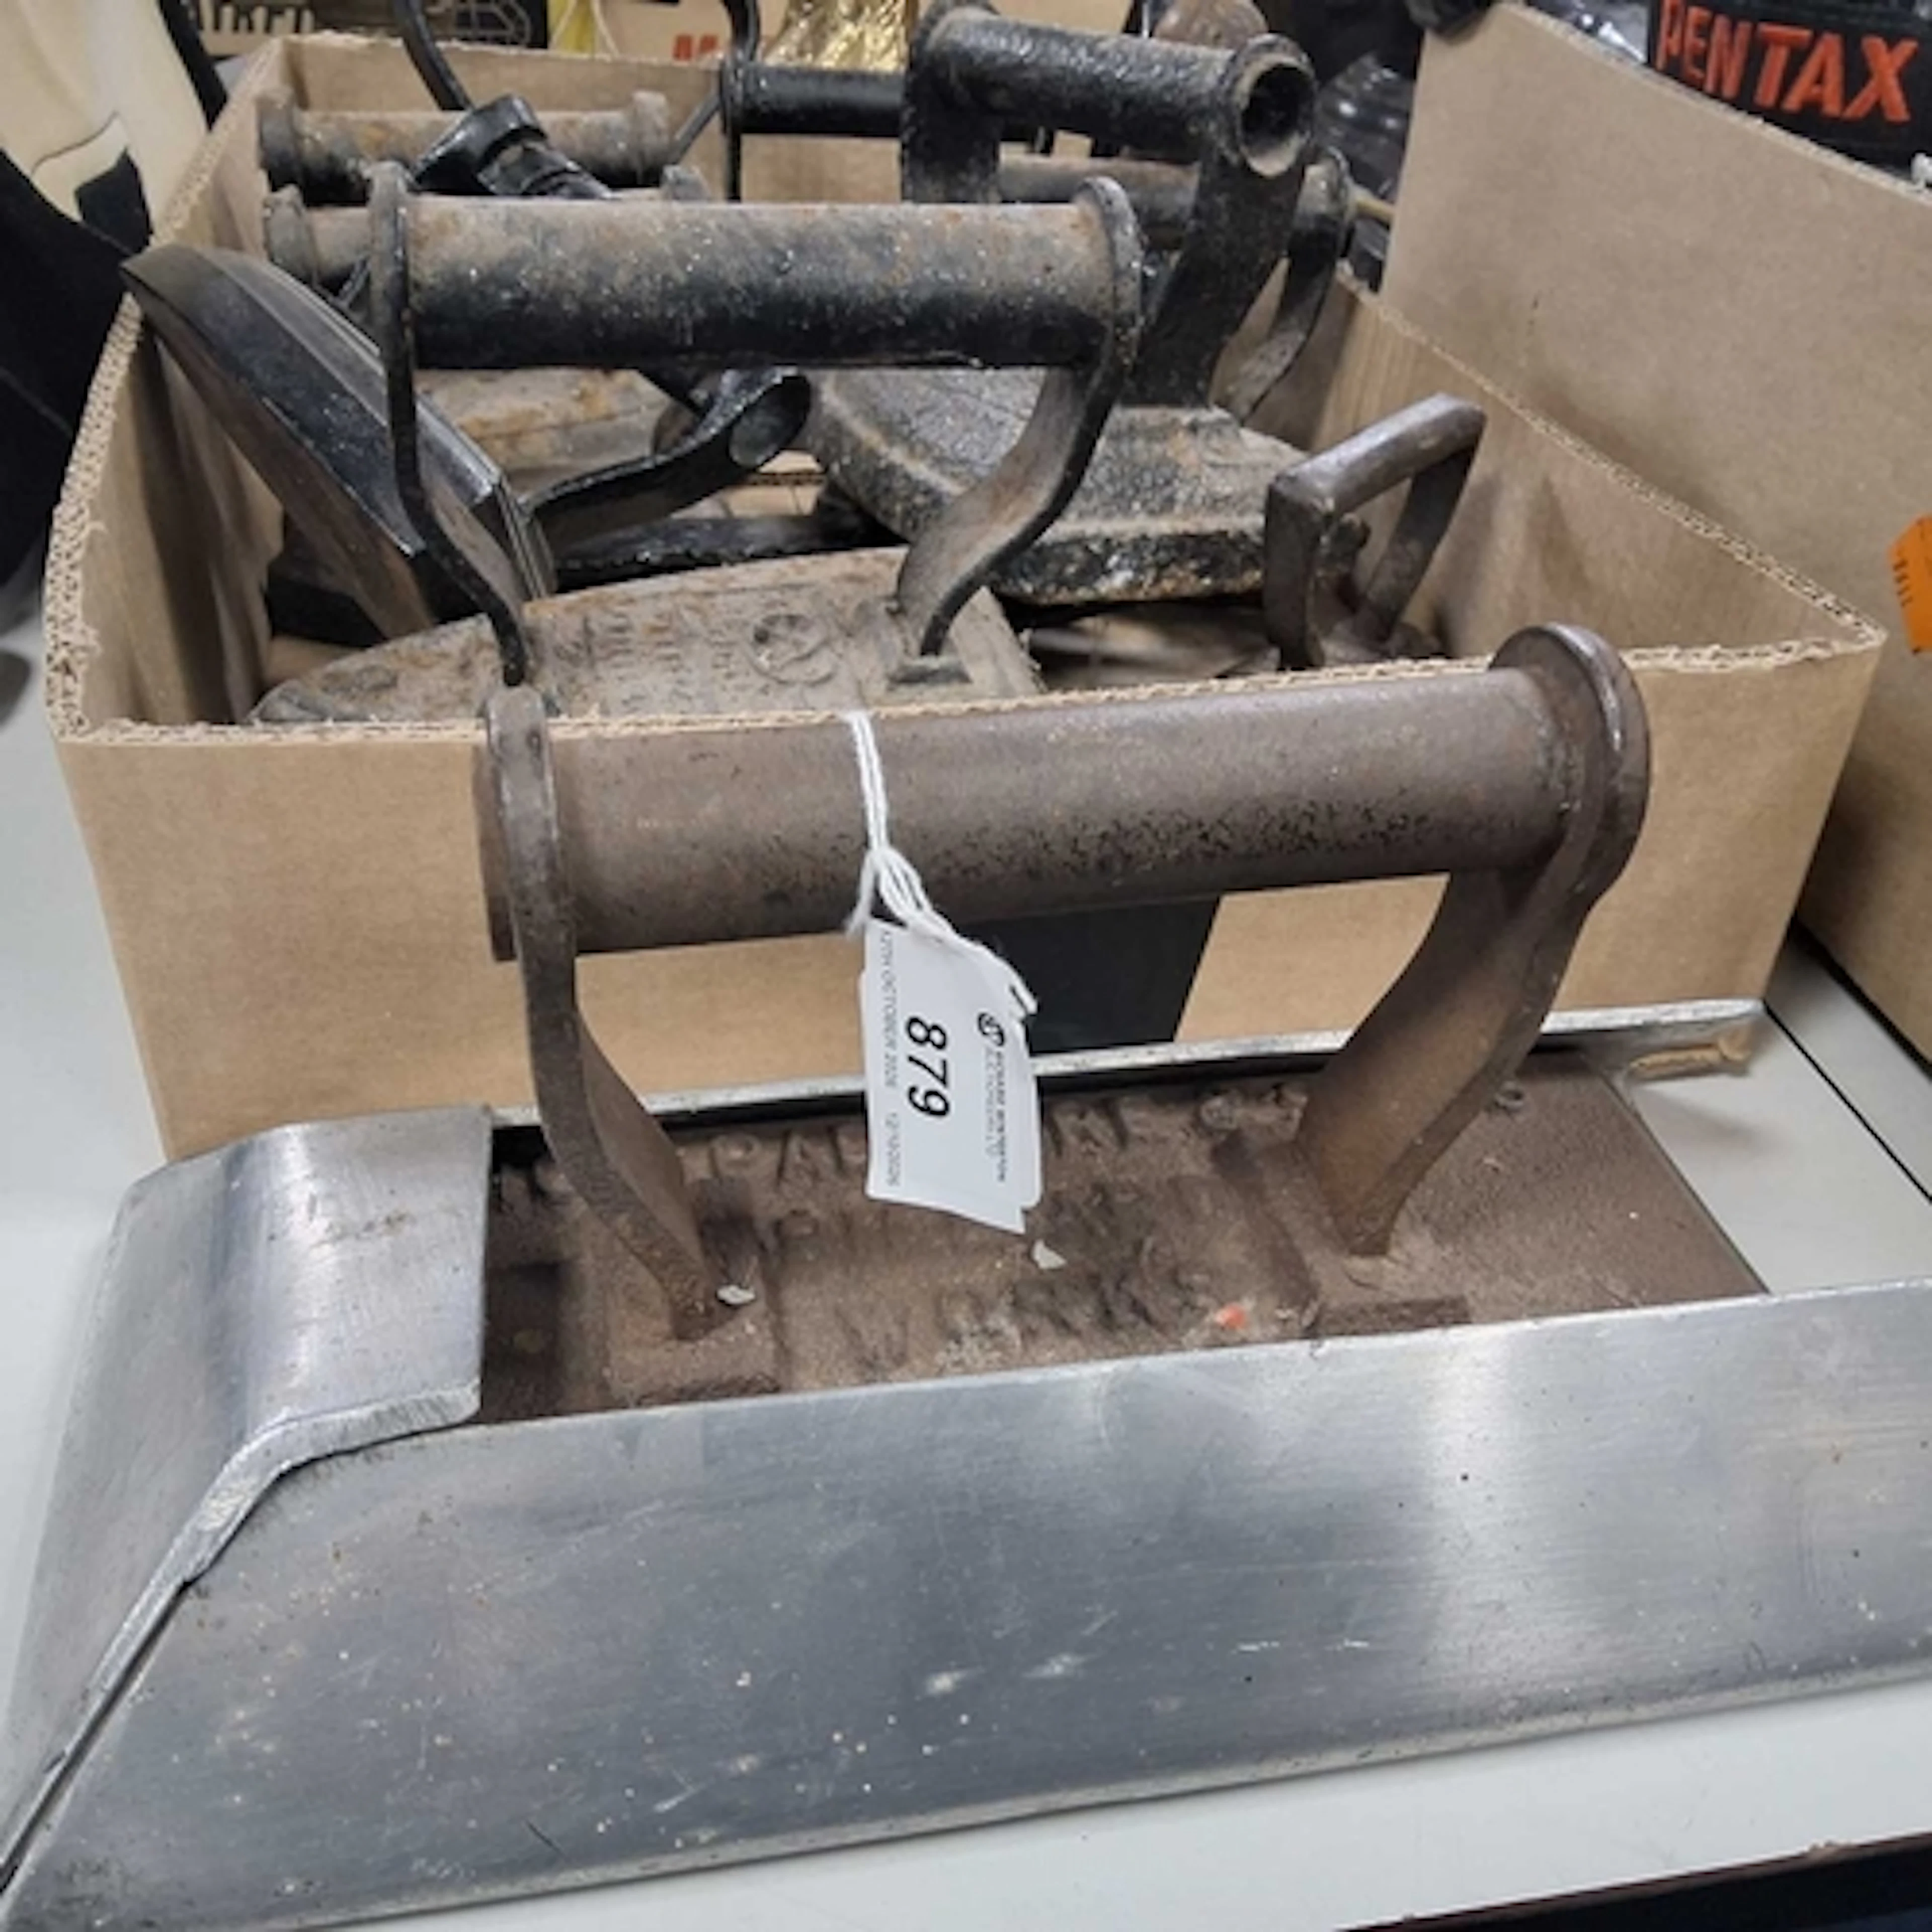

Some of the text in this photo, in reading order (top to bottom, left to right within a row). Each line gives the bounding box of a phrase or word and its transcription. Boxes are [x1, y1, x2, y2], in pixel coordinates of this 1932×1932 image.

[1655, 0, 1918, 123] PENTAX
[880, 970, 898, 1051] OCTOBER
[907, 1016, 950, 1117] 879
